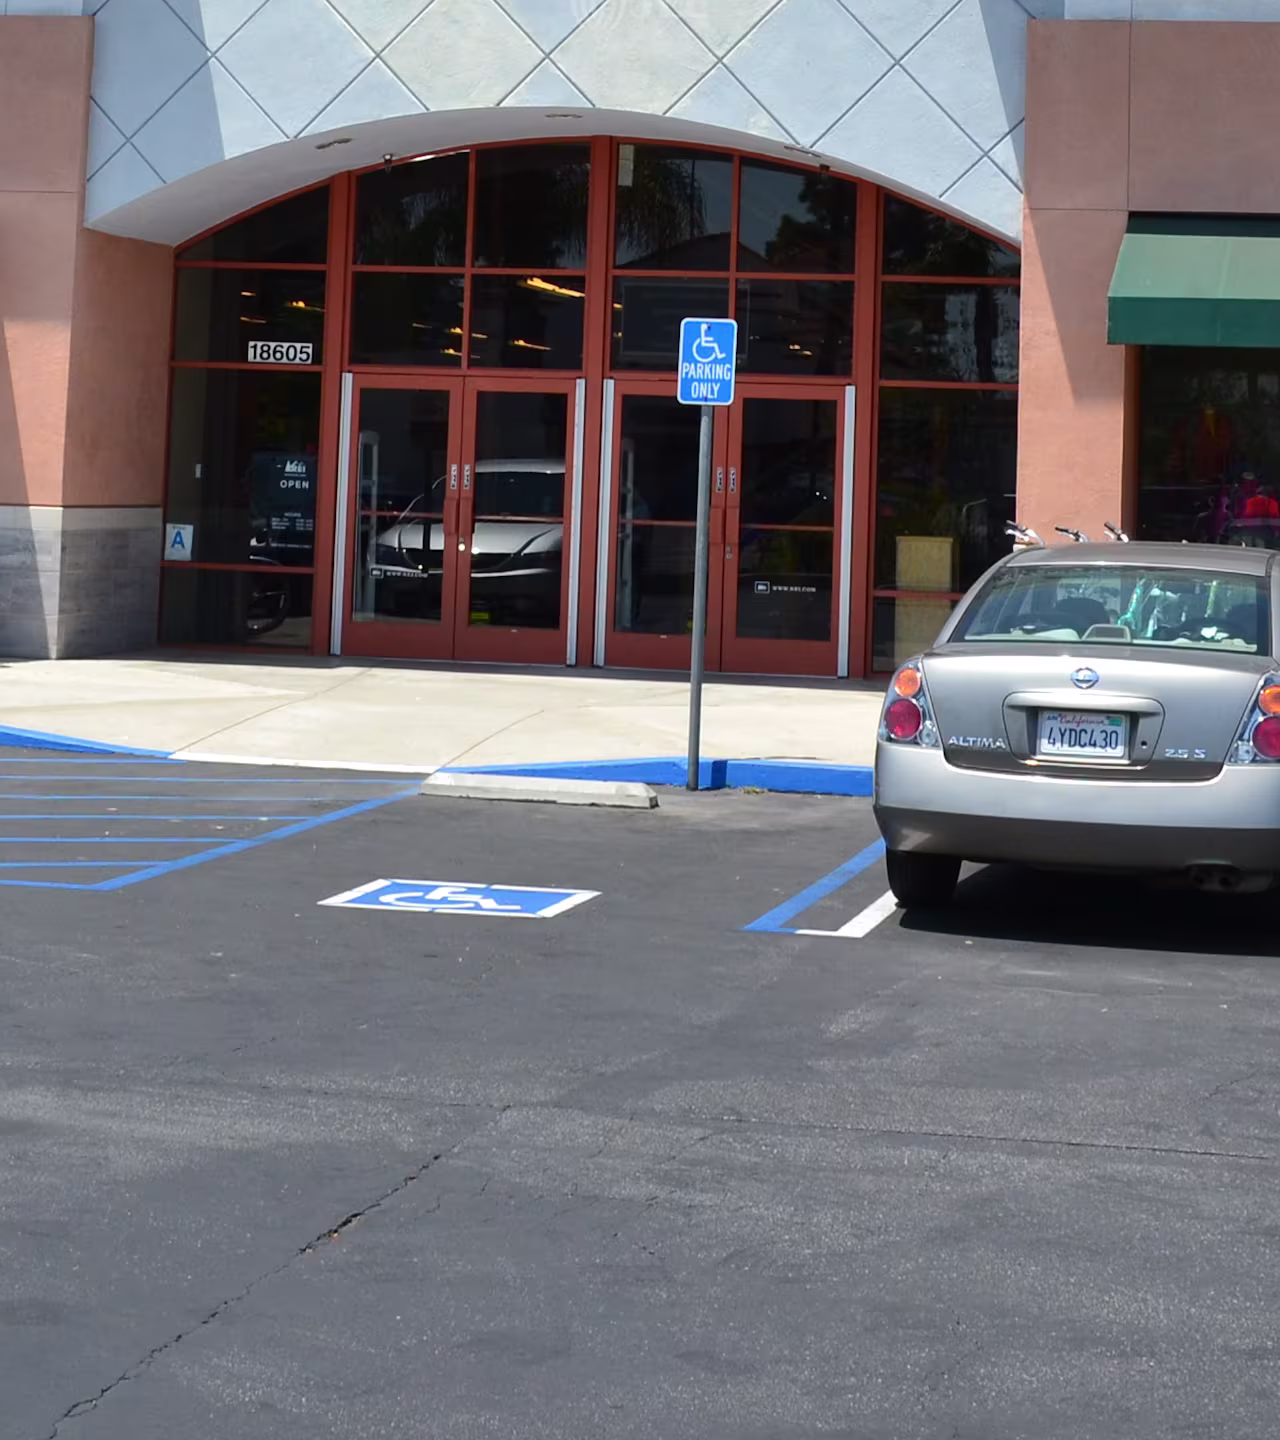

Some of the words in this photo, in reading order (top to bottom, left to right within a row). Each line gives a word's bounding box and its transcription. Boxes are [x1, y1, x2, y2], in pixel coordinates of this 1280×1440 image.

[250, 343, 311, 362] 18605
[682, 362, 732, 380] PARKING
[691, 381, 720, 398] ONLY
[280, 479, 309, 488] OPEN
[171, 530, 184, 549] A
[1058, 713, 1105, 728] California
[948, 736, 1006, 748] ALTIMA
[1047, 726, 1119, 750] 4YDC430
[1193, 748, 1206, 758] S
